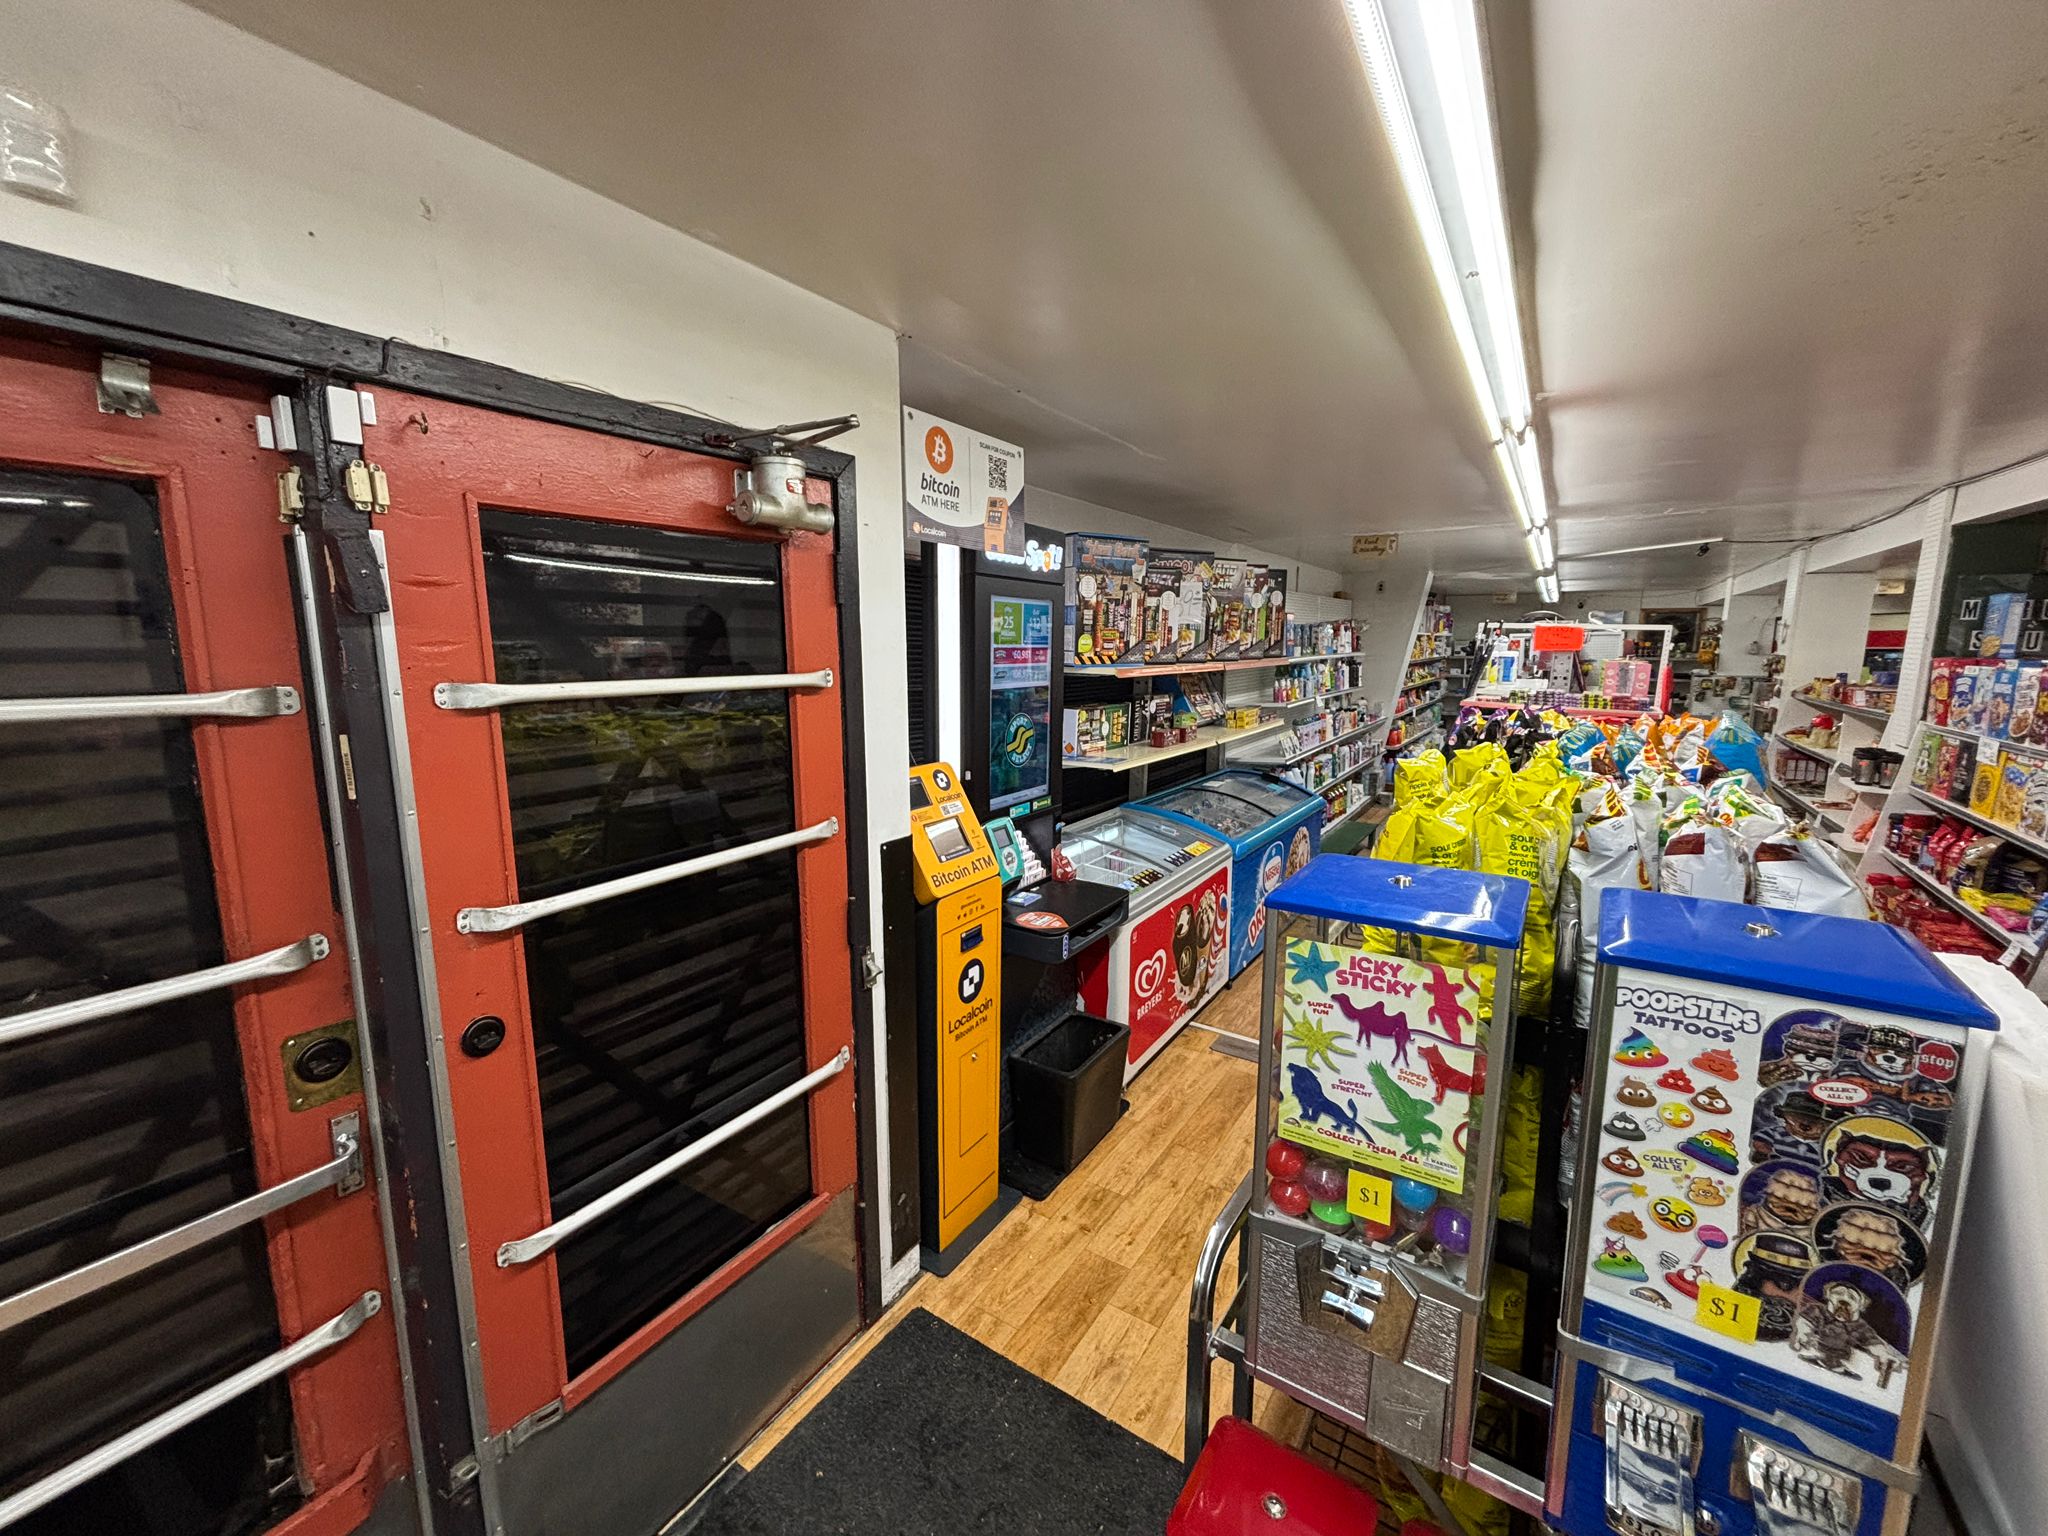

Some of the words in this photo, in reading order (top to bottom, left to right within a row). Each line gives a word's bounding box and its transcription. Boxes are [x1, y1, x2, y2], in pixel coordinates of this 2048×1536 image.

[979, 441, 990, 451] SCAN
[999, 447, 1016, 459] COUPON
[921, 473, 960, 498] bitcoin
[921, 496, 939, 508] ATM
[940, 499, 960, 512] HERE
[920, 524, 947, 538] Localcoin
[1010, 717, 1028, 732] SPORT
[1012, 744, 1032, 763] SELECT
[935, 792, 963, 803] Localcoin
[1510, 834, 1535, 843] sour
[1430, 844, 1451, 853] sour
[931, 865, 971, 888] Bitcoin
[971, 856, 995, 874] ATM
[1507, 868, 1518, 876] et
[1349, 956, 1404, 978] ICKY
[1335, 970, 1417, 998] STICKY
[1137, 990, 1163, 1020] BREYERS
[1307, 1000, 1334, 1010] SUPER
[1312, 1008, 1330, 1016] FUN
[1616, 986, 1761, 1034] POOPSTERS
[948, 997, 993, 1034] Localcoin
[954, 1023, 975, 1042] Bitcoin
[974, 1016, 988, 1031] ATM
[1634, 1011, 1736, 1043] TATTOOS
[1919, 1055, 1955, 1070] stop
[1397, 1074, 1428, 1089] STICKY
[1399, 1068, 1429, 1083] SUPER
[1331, 1083, 1373, 1098] STRETCHY
[1338, 1078, 1366, 1091] SUPER
[1819, 1085, 1859, 1094] COLLECT
[1317, 1127, 1363, 1147] COLLECT
[1365, 1141, 1397, 1157] THEM
[1399, 1153, 1420, 1165] ALL
[1431, 1158, 1458, 1170] WARNING
[1642, 1154, 1689, 1166] COLLECT
[1651, 1161, 1671, 1171] ALL
[1672, 1164, 1683, 1172] 15
[1359, 1187, 1379, 1206] $1
[1709, 1297, 1741, 1323] $1
